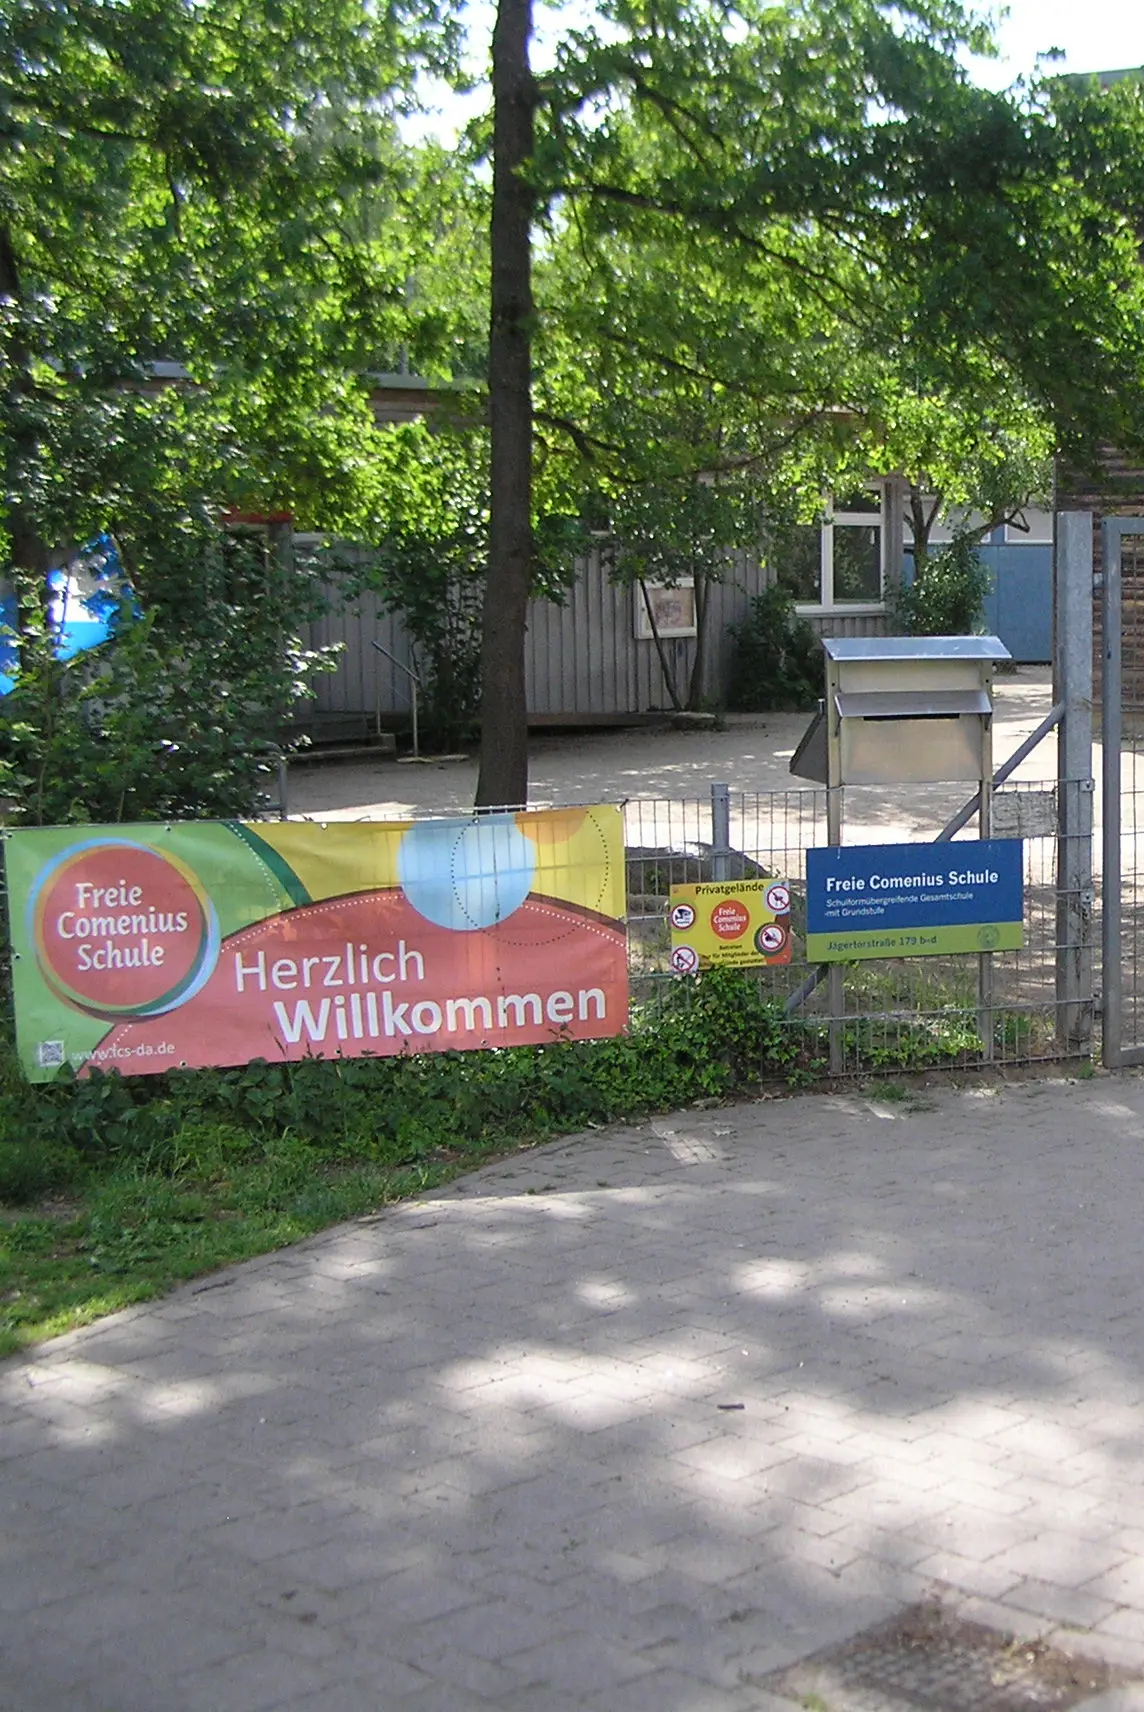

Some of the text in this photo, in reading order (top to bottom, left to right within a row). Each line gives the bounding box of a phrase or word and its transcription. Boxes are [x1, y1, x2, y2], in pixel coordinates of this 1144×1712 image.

[75, 879, 143, 909] Freie
[695, 882, 764, 896] Privatgelände
[826, 869, 999, 892] Freie Comenius Schule
[919, 891, 974, 902] Gesamtschule
[57, 906, 188, 939] Comenius
[77, 938, 165, 971] Schule
[899, 936, 918, 946] 179
[235, 940, 424, 992] Herzlich
[273, 987, 606, 1043] Willkommen
